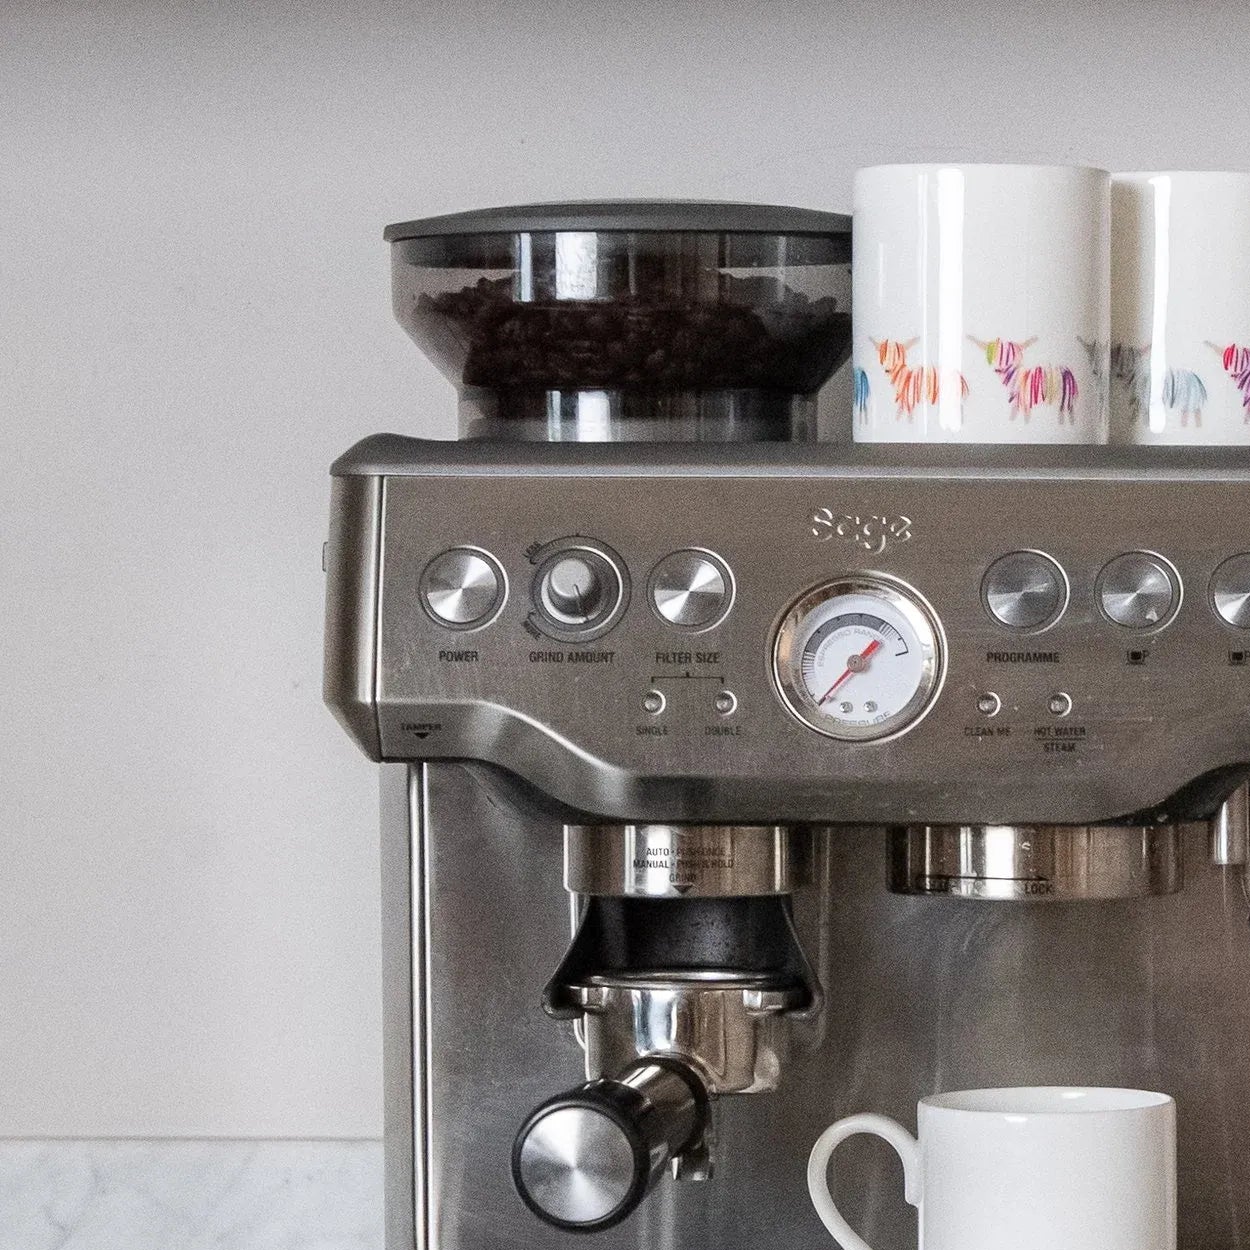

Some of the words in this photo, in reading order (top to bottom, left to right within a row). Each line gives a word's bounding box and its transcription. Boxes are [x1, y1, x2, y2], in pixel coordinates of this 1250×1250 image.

[438, 650, 479, 663] POWER
[529, 650, 564, 664] GRIND
[567, 650, 615, 664] AMOUNT
[655, 652, 692, 664] FILTER
[695, 652, 721, 664] SIZE
[986, 651, 1060, 664] PROGRAMME
[636, 725, 668, 736] SINGLE
[704, 725, 742, 736] DOUBLE
[964, 726, 994, 737] CLEAN
[1054, 726, 1086, 737] WATER
[646, 847, 670, 856] AUTO
[633, 859, 669, 869] MANUAL
[1024, 883, 1054, 895] LOCK
